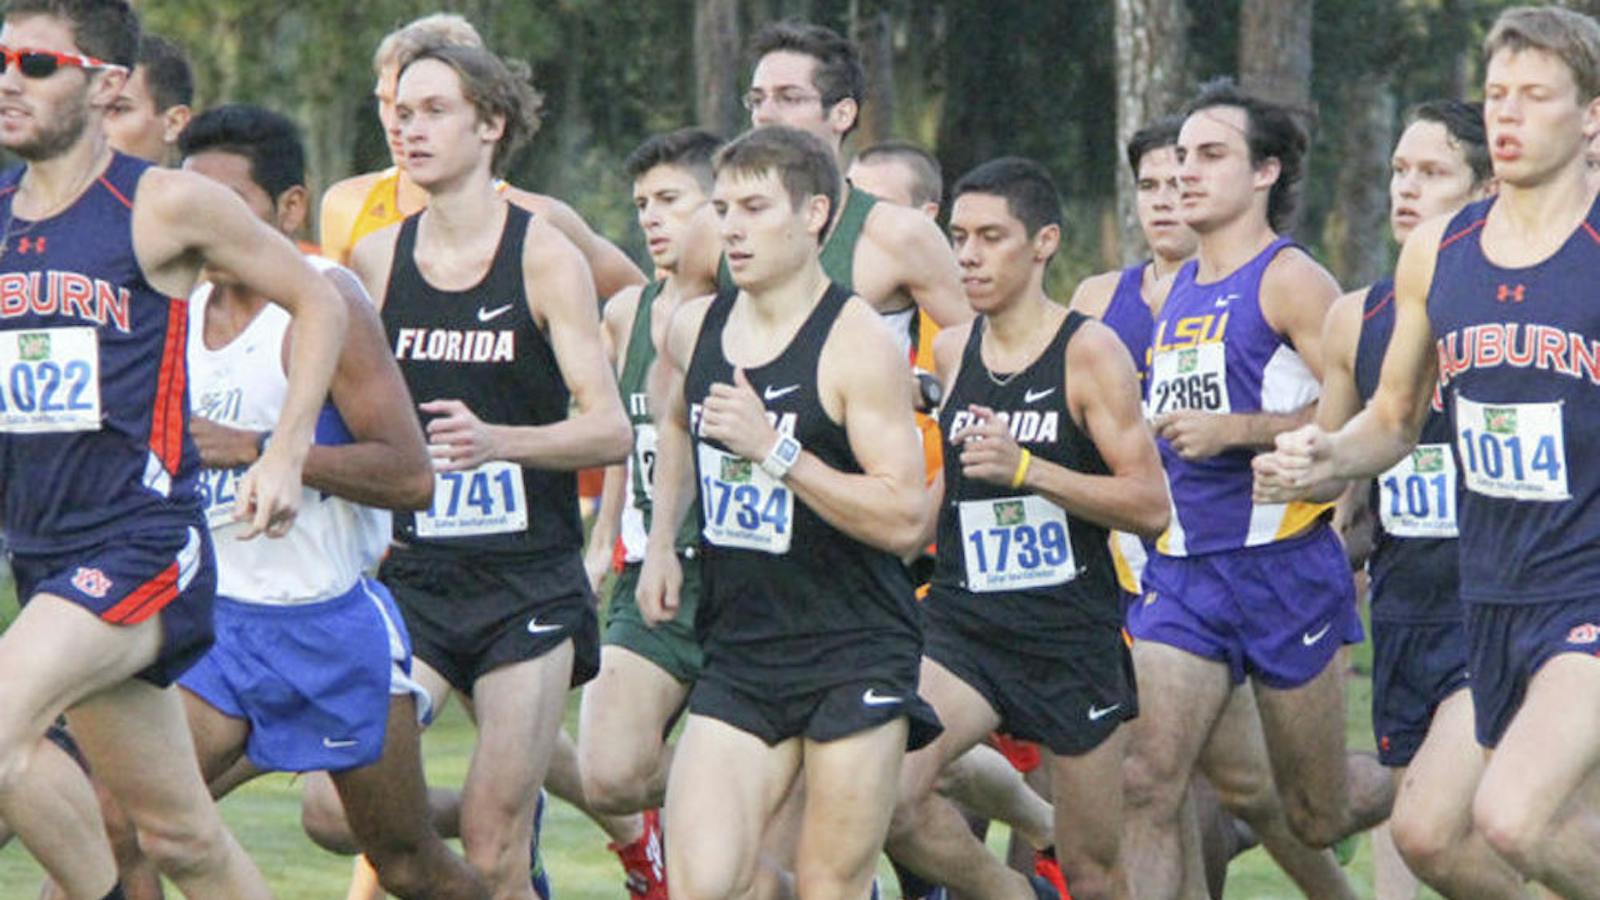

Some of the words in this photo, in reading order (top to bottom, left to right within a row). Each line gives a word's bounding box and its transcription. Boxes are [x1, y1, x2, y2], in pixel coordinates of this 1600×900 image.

[395, 328, 516, 362] FLORIDA
[1155, 311, 1230, 352] LSU
[0, 359, 93, 413] 022
[1155, 371, 1222, 415] 2365
[948, 409, 1060, 443] FLIDA
[1462, 428, 1560, 481] 1014
[703, 475, 788, 535] 1734
[968, 520, 1068, 574] 1739
